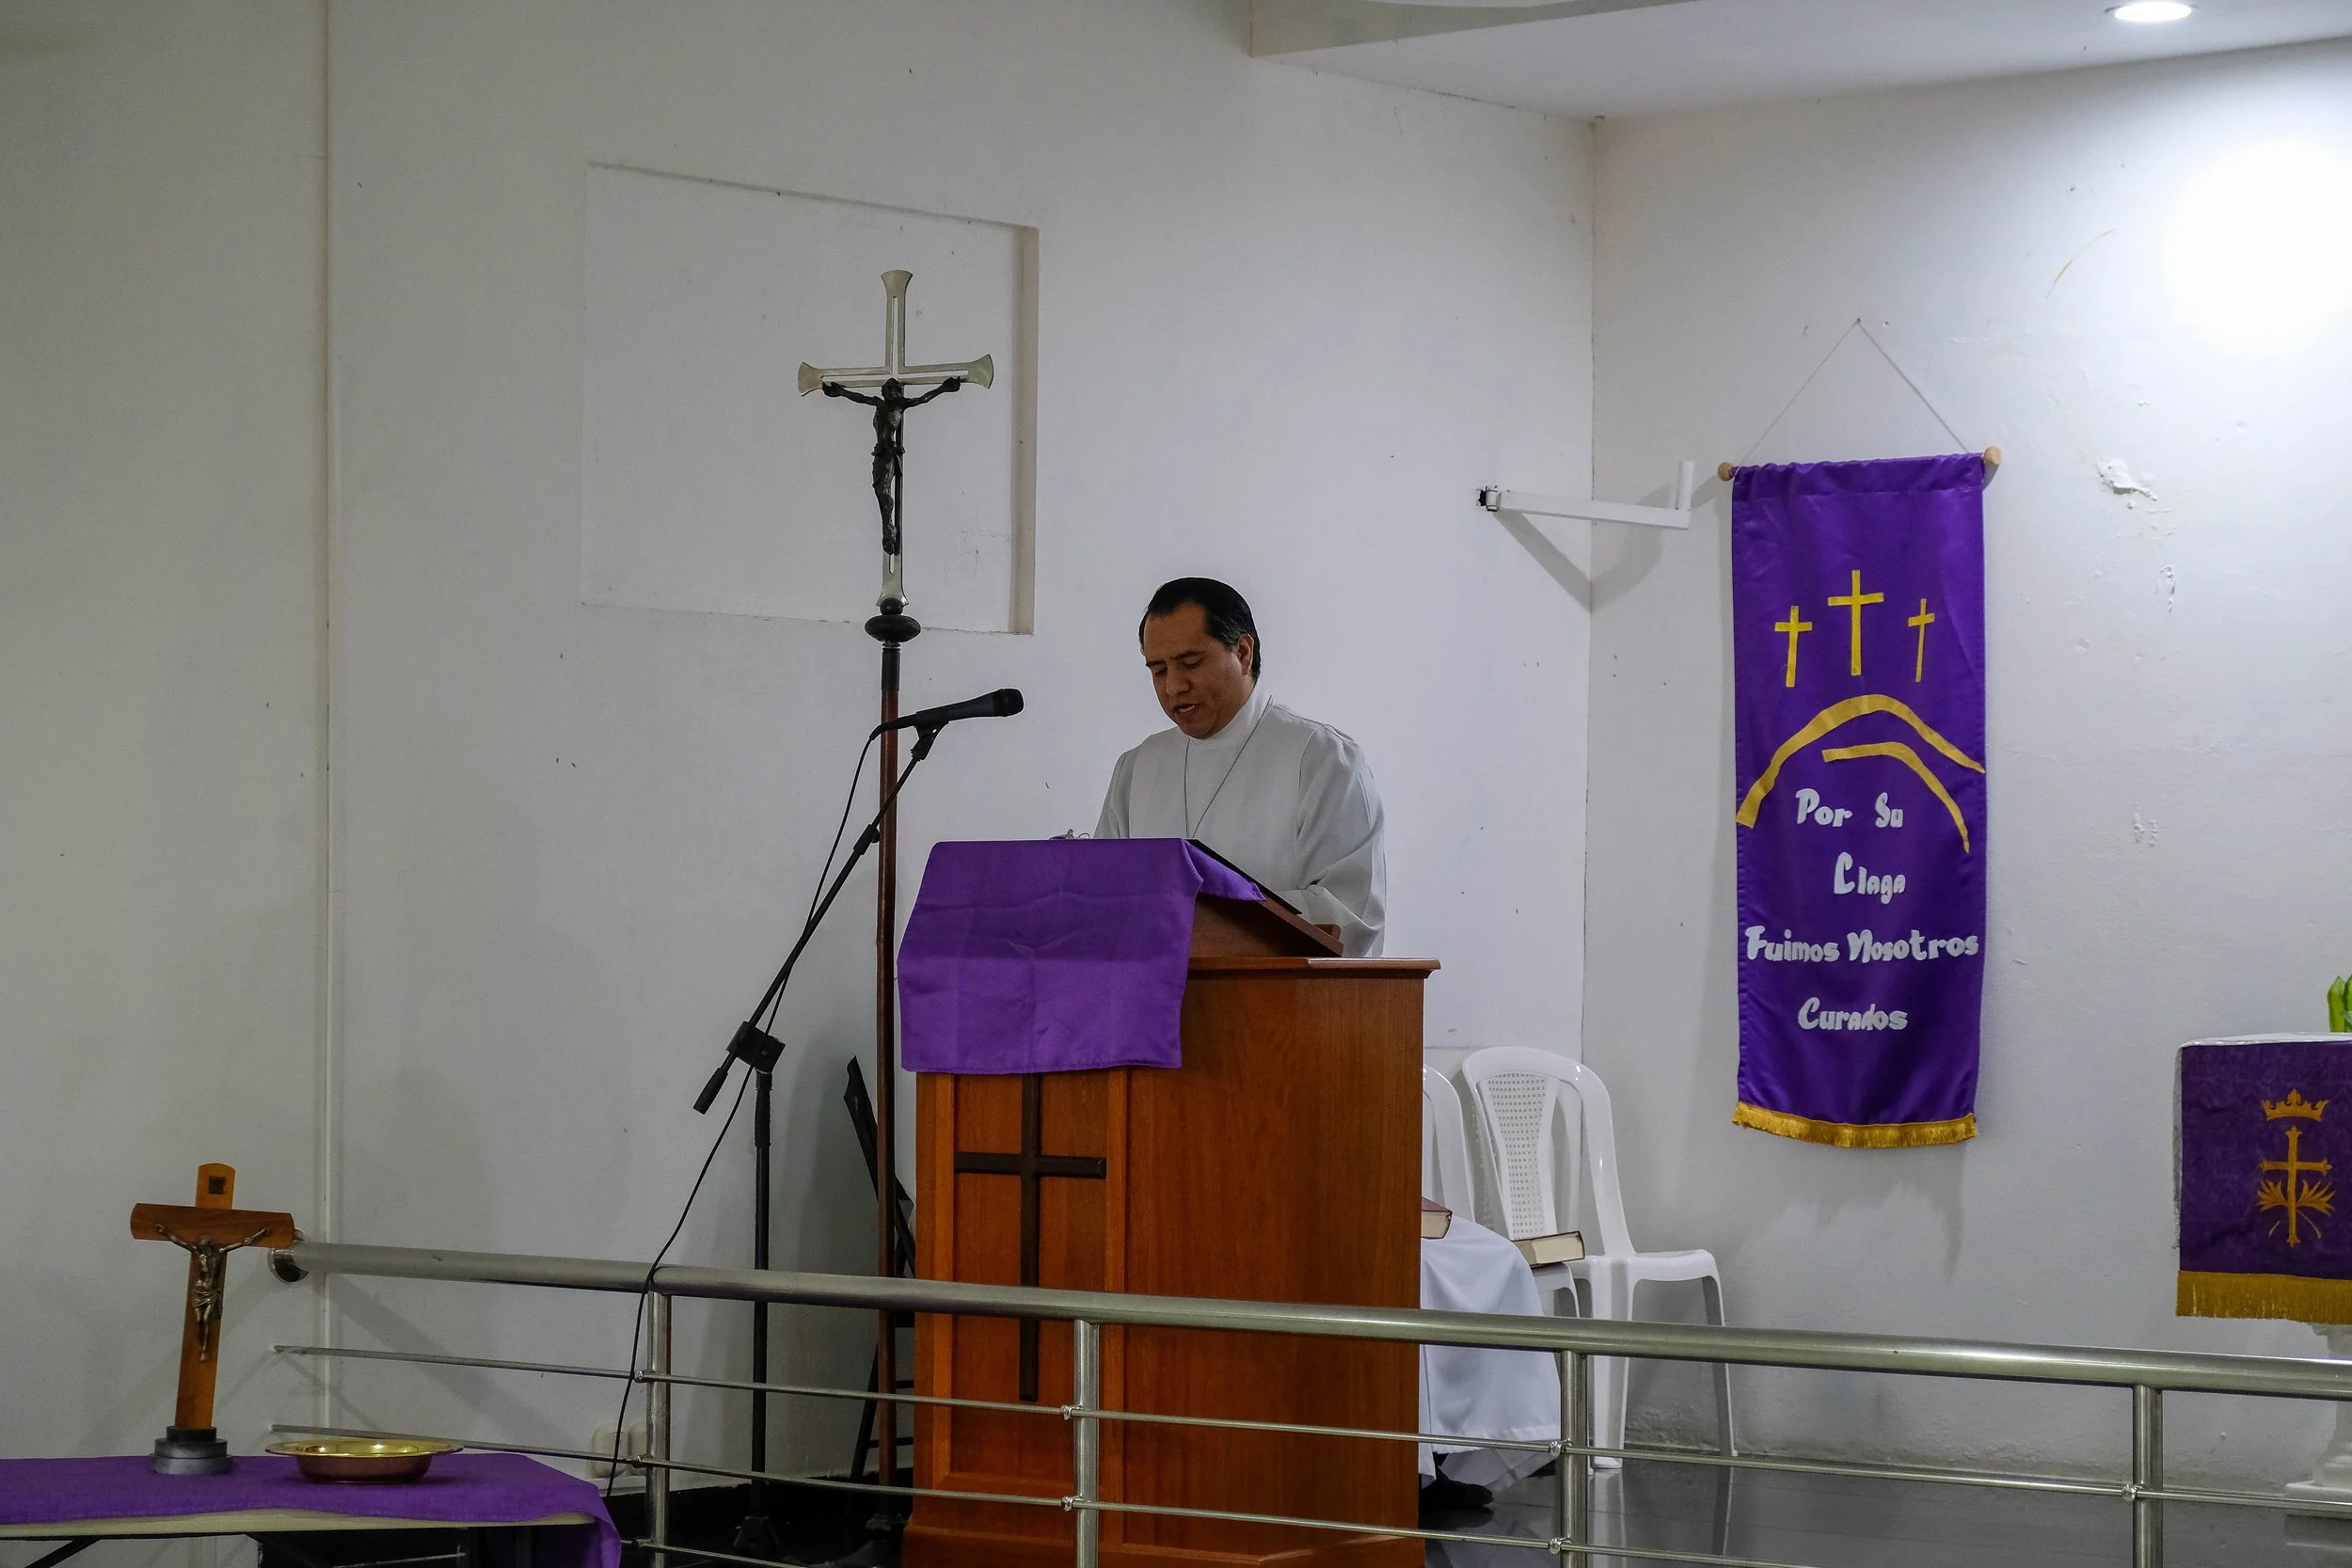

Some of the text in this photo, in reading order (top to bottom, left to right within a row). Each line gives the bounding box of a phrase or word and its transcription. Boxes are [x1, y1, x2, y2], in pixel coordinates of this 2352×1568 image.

[1795, 788, 1904, 829] Por Su
[1744, 926, 1979, 963] Fuimos Nosotros
[1798, 997, 1908, 1031] Curados
